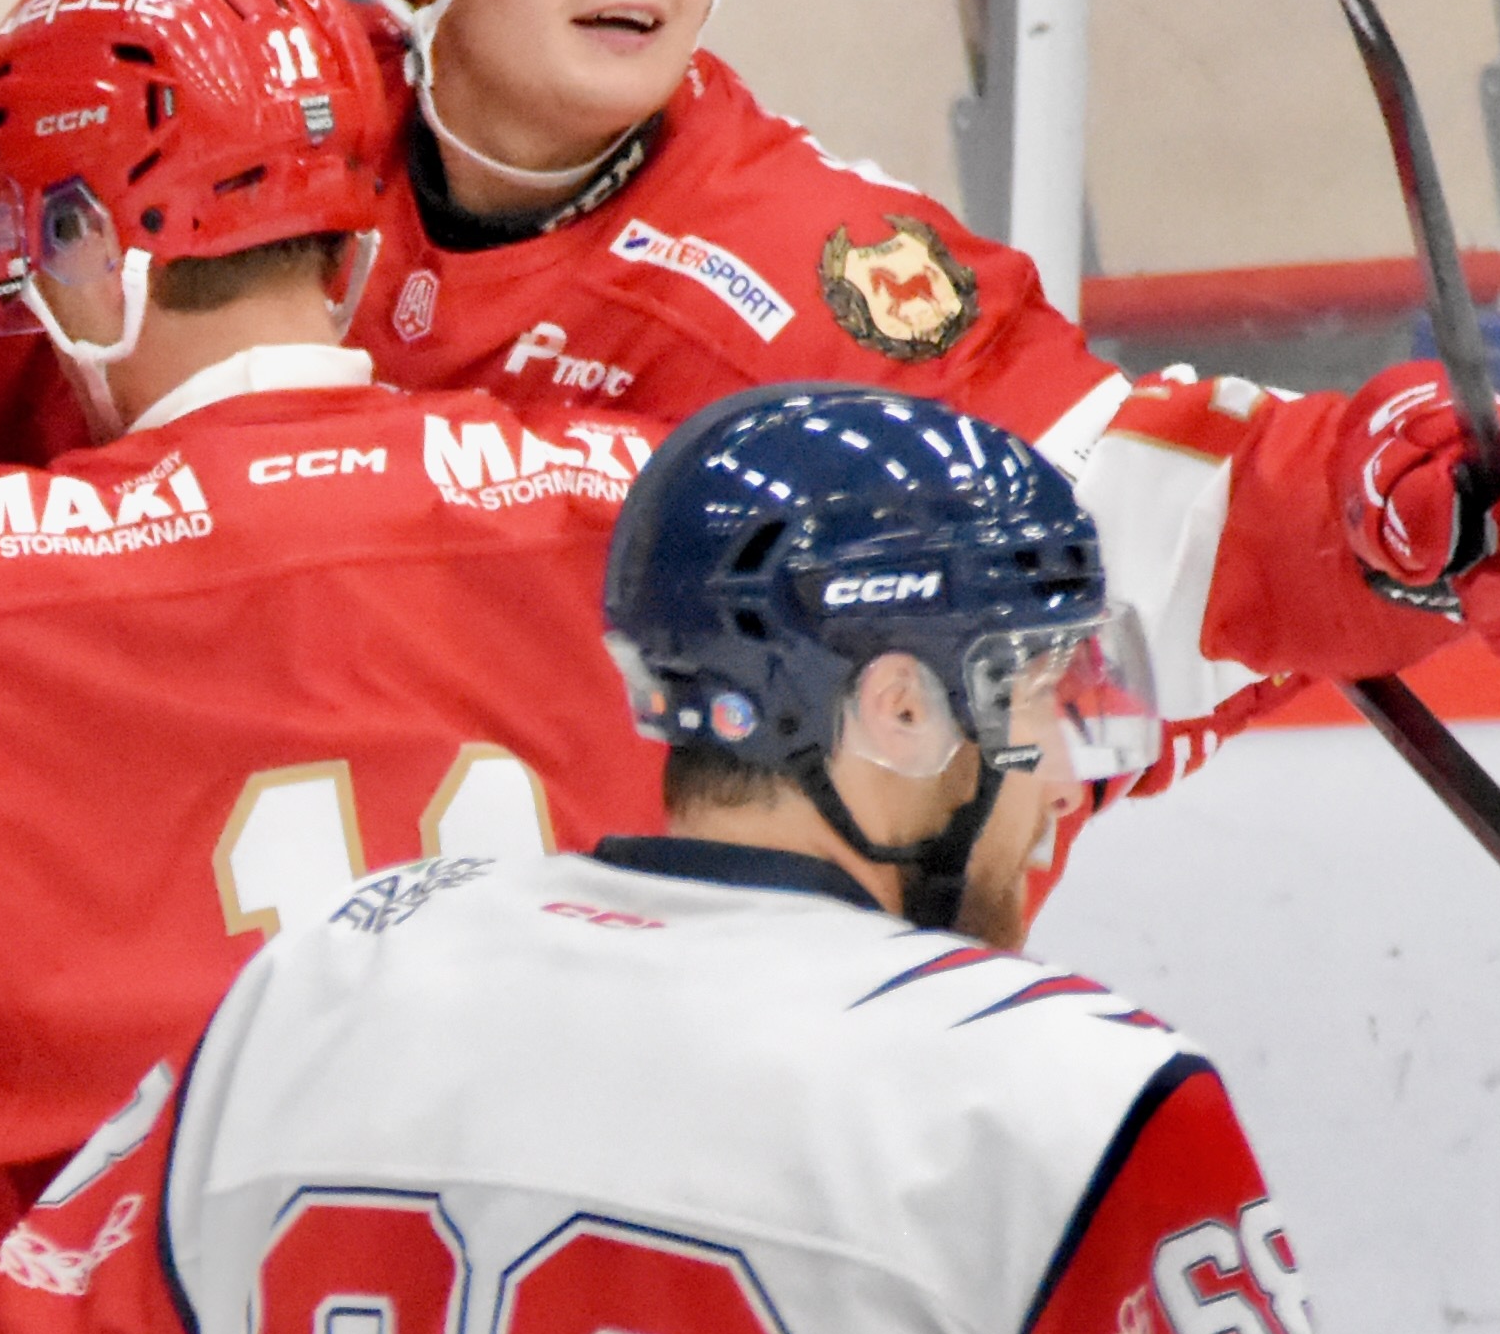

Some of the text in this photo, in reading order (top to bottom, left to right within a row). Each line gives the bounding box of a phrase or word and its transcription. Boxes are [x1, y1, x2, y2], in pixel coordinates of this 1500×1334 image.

[268, 27, 319, 87] 11
[35, 105, 108, 136] CCM
[248, 448, 388, 486] CCM
[478, 469, 634, 511] STORMARKN
[823, 571, 942, 608] CCM
